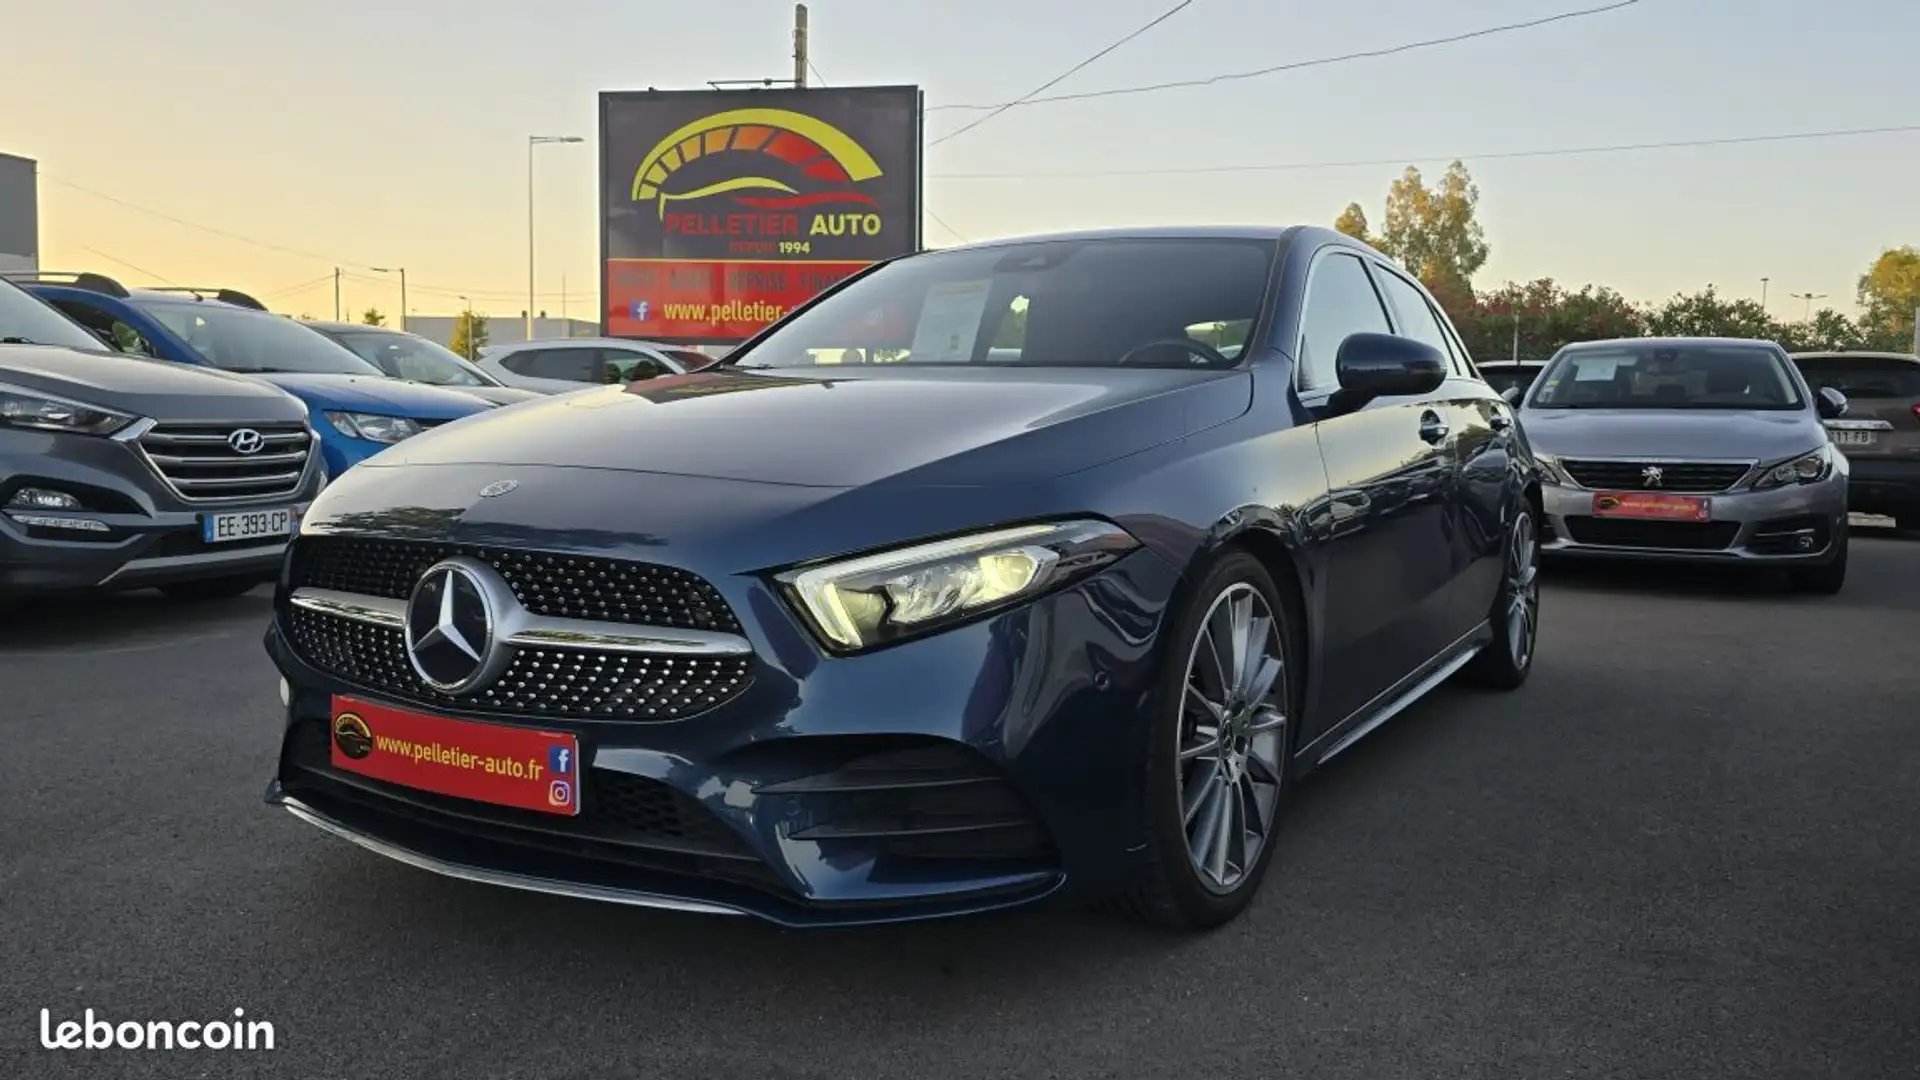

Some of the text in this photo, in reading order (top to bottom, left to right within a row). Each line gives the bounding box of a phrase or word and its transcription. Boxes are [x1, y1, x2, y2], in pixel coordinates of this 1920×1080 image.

[665, 214, 881, 235] PELLETIER AUTO
[779, 241, 810, 254] 1994
[218, 512, 288, 537] EE-393-CP
[376, 734, 544, 781] www.pelletier-auto.fr
